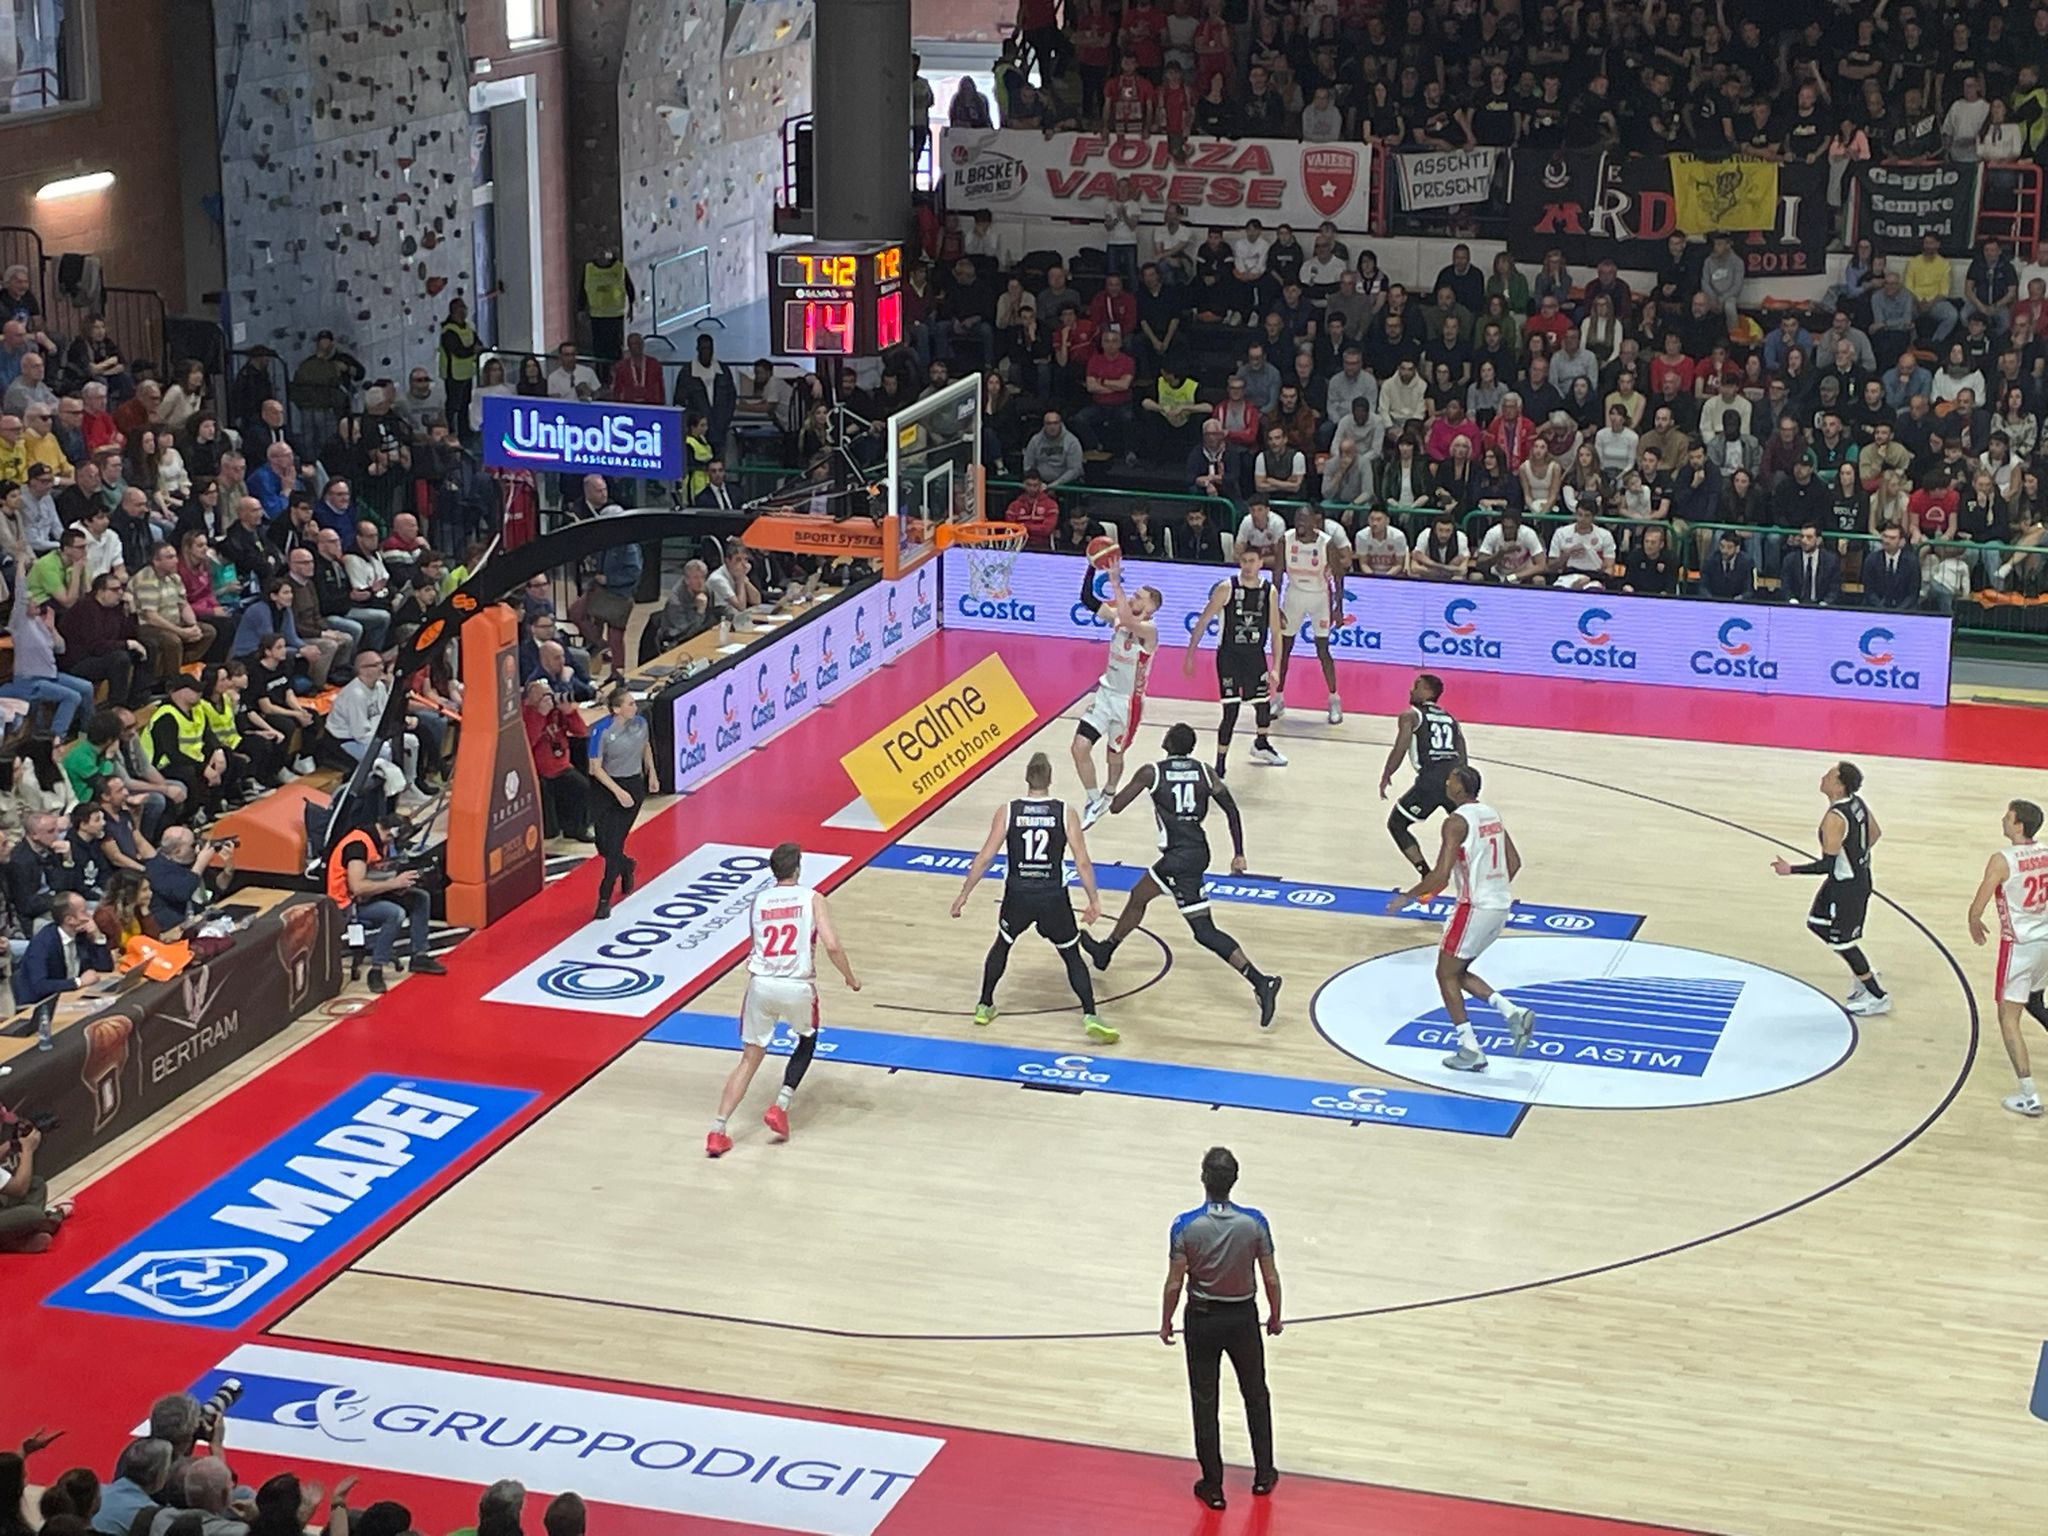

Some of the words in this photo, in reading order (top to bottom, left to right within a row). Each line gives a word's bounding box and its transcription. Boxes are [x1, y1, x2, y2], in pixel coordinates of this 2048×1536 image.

[1070, 137, 1273, 175] FORZA
[1413, 151, 1490, 176] ASSENTI
[954, 168, 966, 187] IL
[968, 160, 1023, 184] BASKET
[1412, 176, 1490, 200] PRESENT
[1868, 166, 1959, 190] Gaggio
[1046, 169, 1287, 209] VARESE
[1871, 194, 1954, 217] Sempre
[1873, 219, 1912, 238] Con
[1747, 252, 1807, 272] 2012
[804, 301, 854, 353] 14
[512, 408, 662, 462] UnipolSai
[574, 454, 662, 469] ASSICURAZIONI
[795, 531, 838, 543] SPORT
[839, 534, 884, 546] SYSTE
[958, 595, 1036, 622] Costa
[1419, 630, 1501, 659] Costa
[1551, 640, 1637, 670] Costa
[1690, 650, 1778, 680] Costa
[1830, 660, 1920, 690] Costa
[883, 686, 986, 774] realme
[1430, 722, 1455, 750] 32
[912, 722, 1001, 795] smartphone
[1172, 783, 1198, 814] 14
[1022, 829, 1049, 861] 12
[1490, 837, 1498, 870] 1
[597, 855, 771, 960] COLOMBO
[763, 923, 798, 958] 22
[152, 1010, 240, 1084] BERTRAM
[1575, 1045, 1683, 1068] ASTM
[1018, 1063, 1111, 1083] Costa
[1311, 1096, 1408, 1117] Costa
[210, 1086, 480, 1243] MAPEI
[372, 1404, 917, 1501] GRUPPODIGIT
